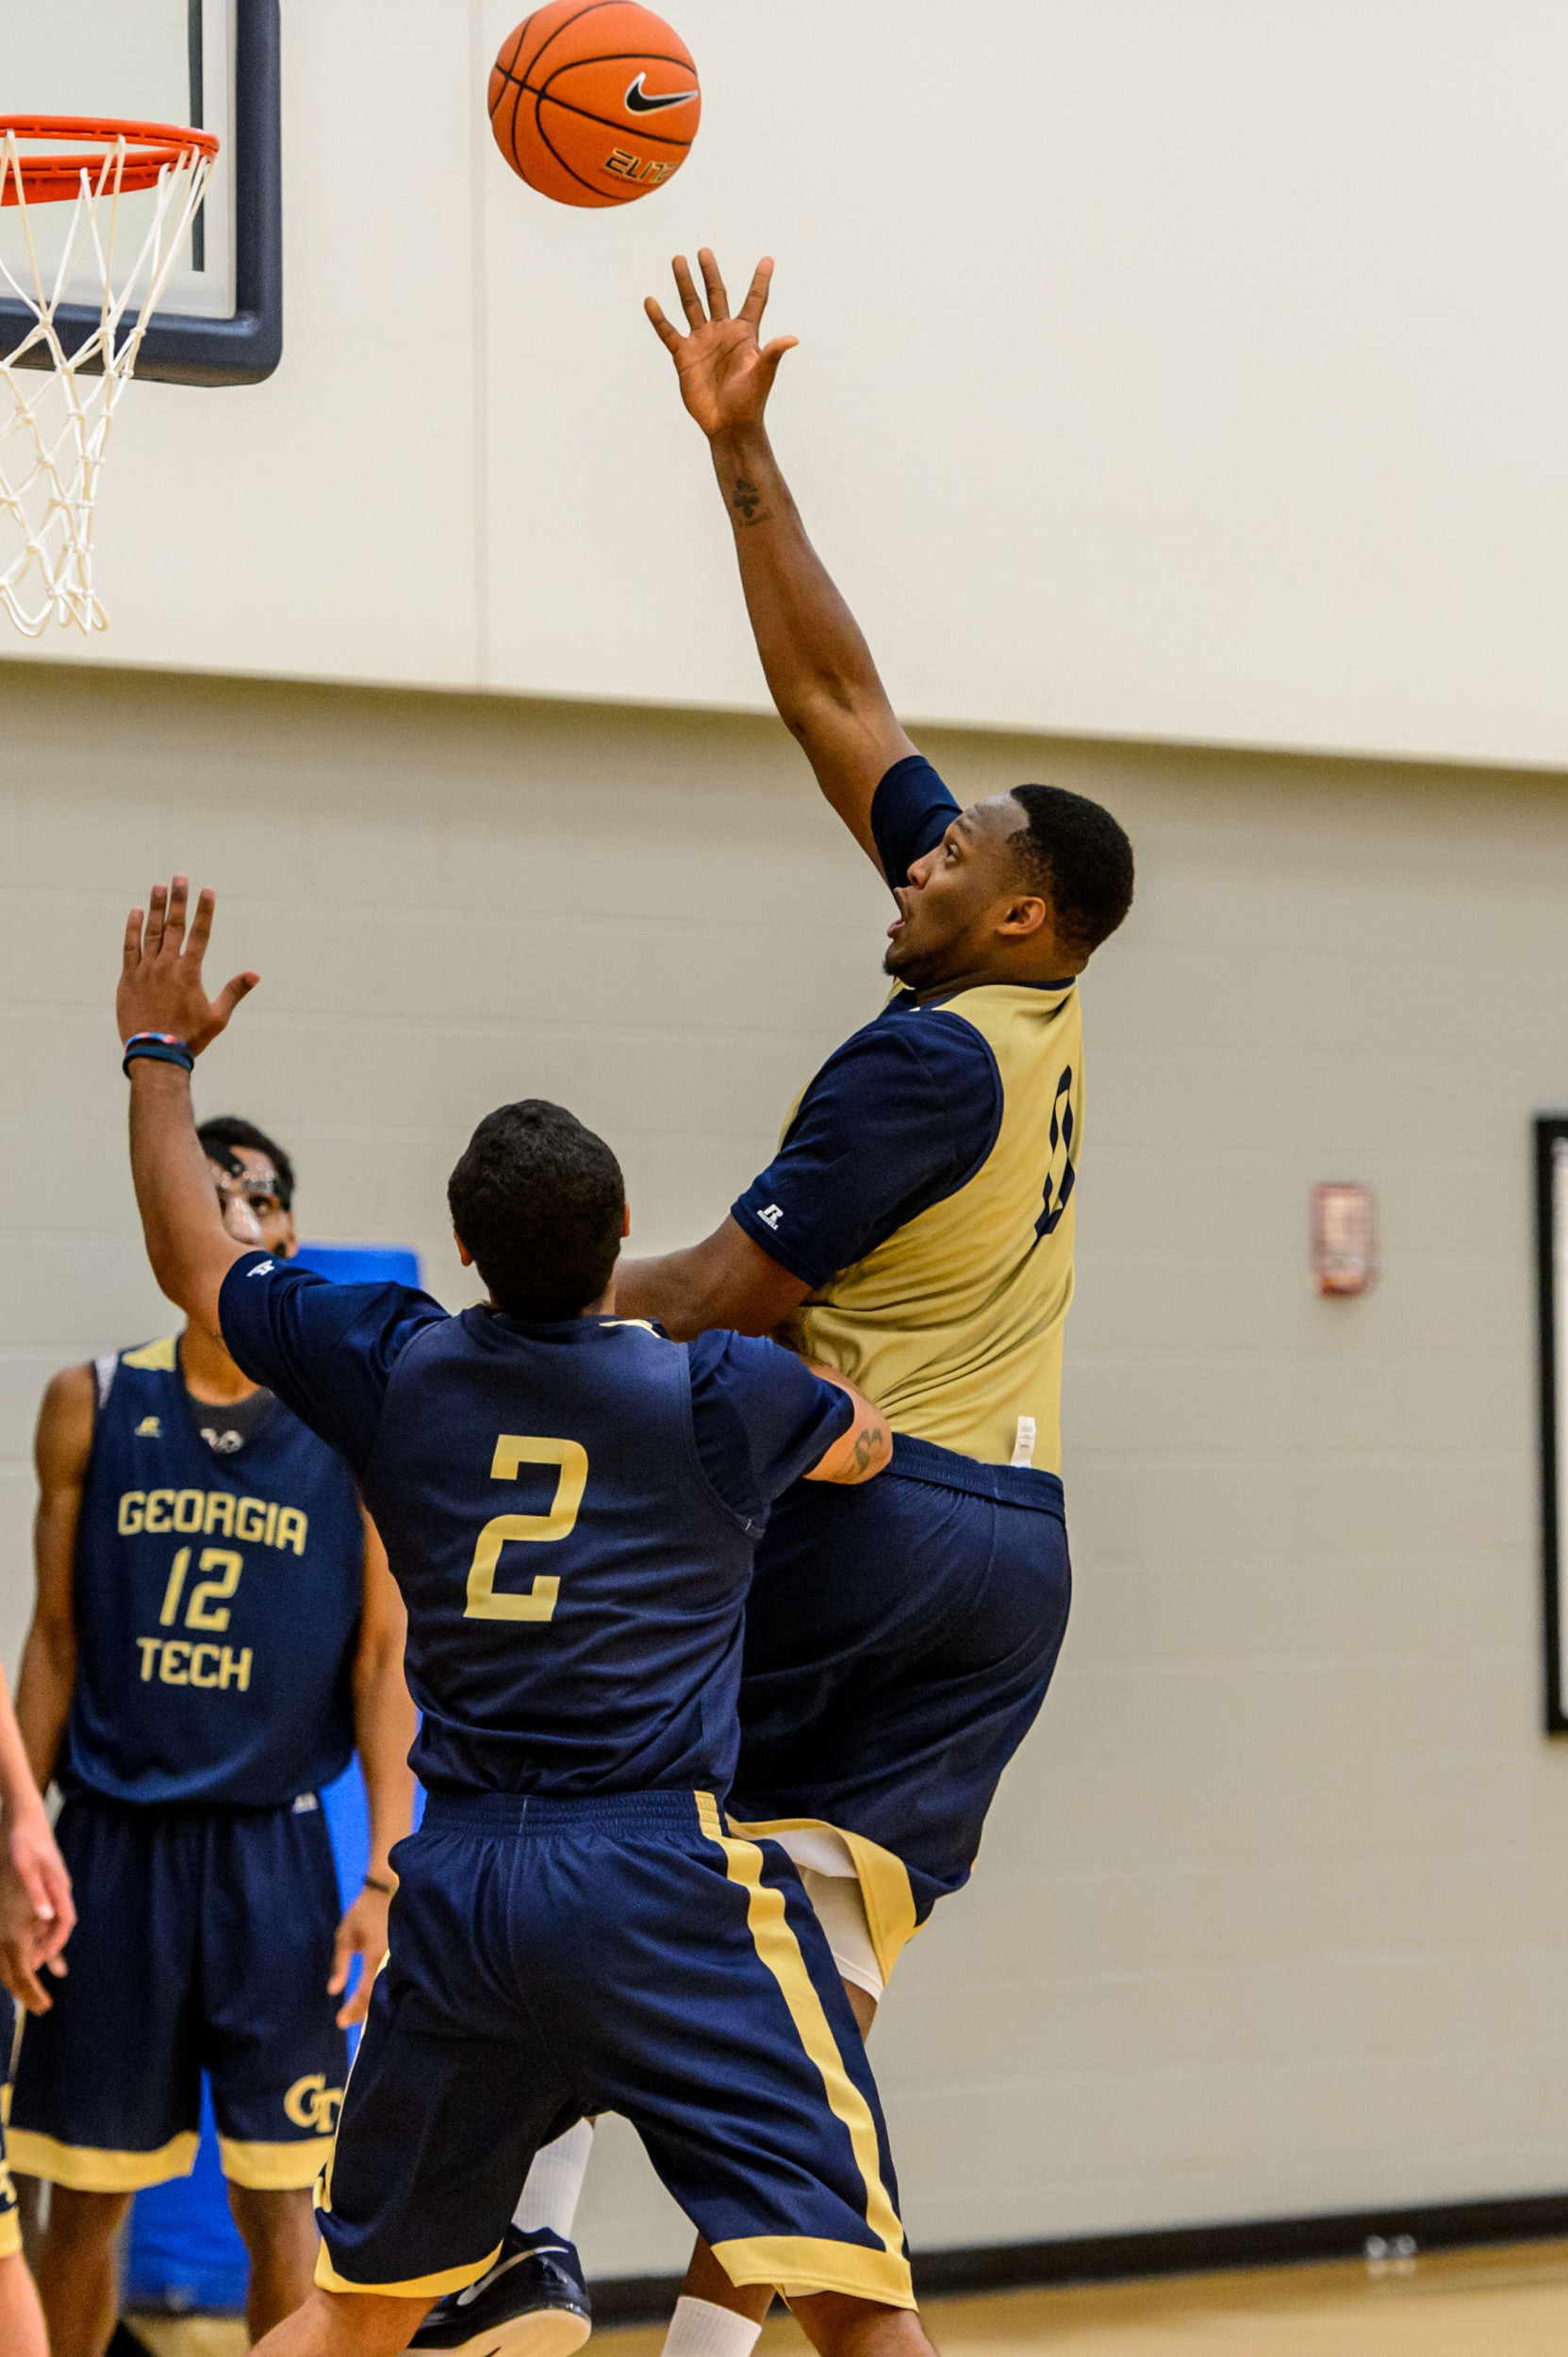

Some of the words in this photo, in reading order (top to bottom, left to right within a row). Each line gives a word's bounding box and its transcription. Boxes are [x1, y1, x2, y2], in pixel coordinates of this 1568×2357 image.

[118, 1489, 307, 1556] GEORGIA
[463, 1434, 588, 1622] 2
[159, 1546, 243, 1632] 12
[136, 1637, 253, 1691] TECH
